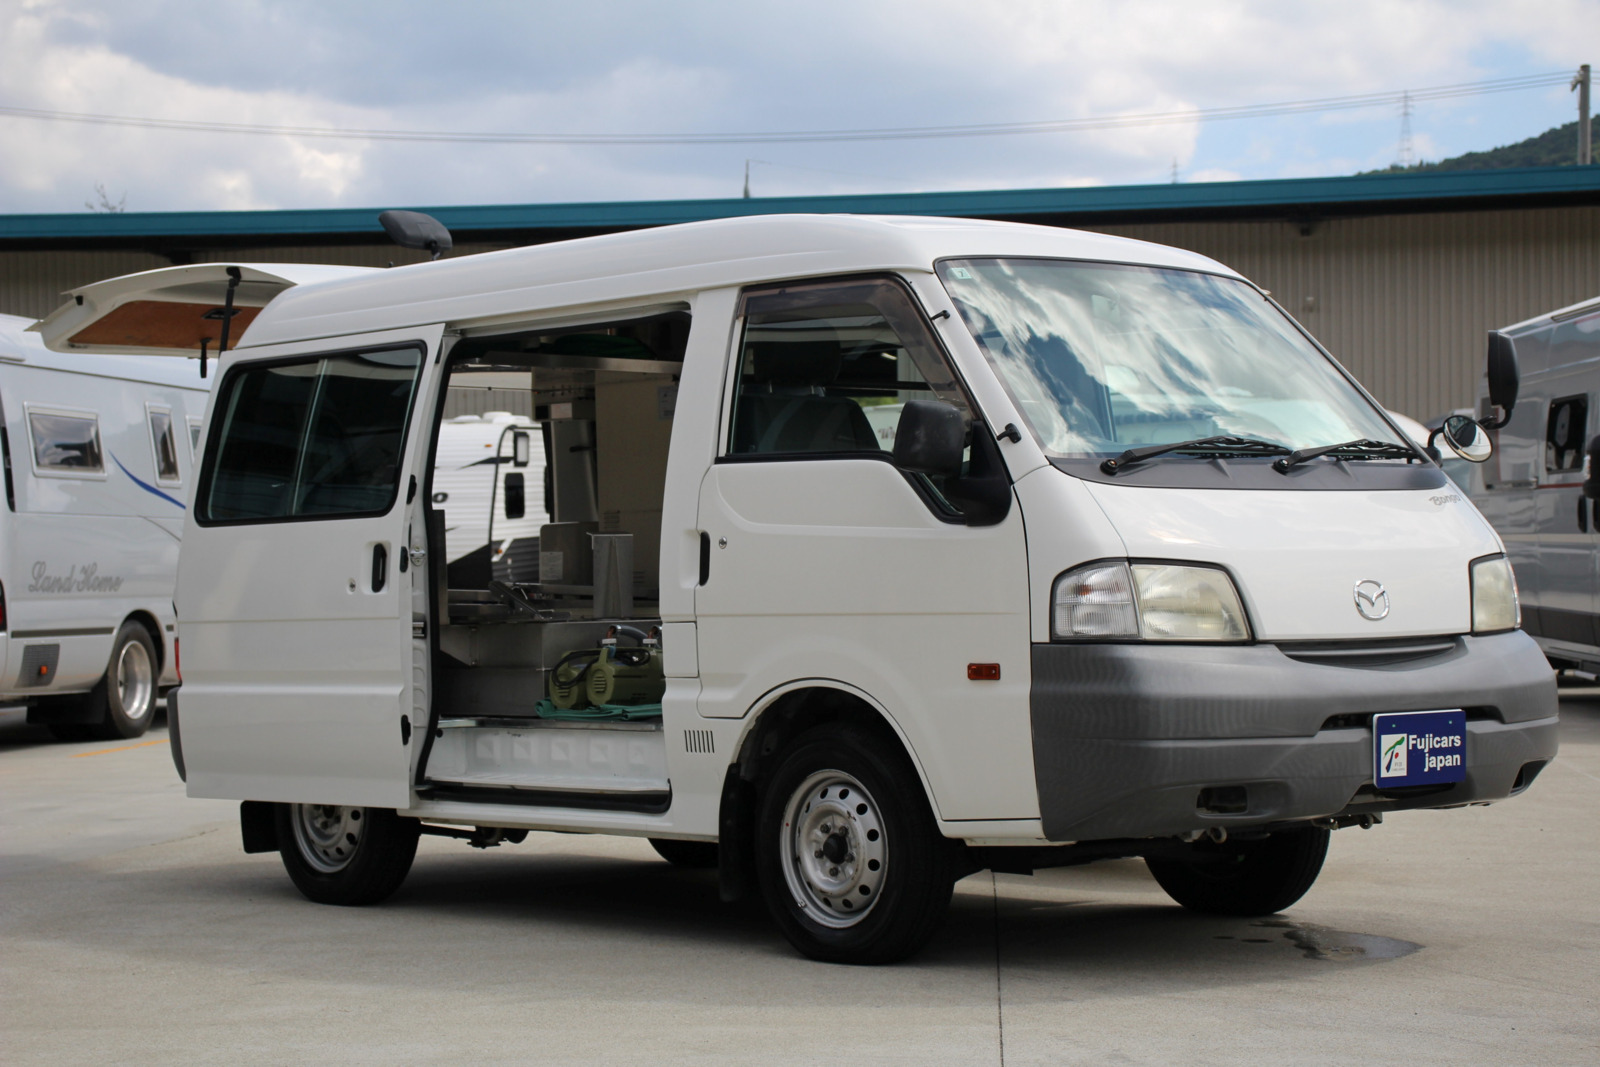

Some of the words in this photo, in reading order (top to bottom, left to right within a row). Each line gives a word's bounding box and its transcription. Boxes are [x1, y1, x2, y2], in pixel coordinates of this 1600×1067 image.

[1429, 494, 1461, 506] Bongo
[28, 560, 77, 593] Land
[77, 562, 125, 593] Home
[1408, 733, 1462, 753] Fujicars
[1423, 753, 1461, 772] japan
